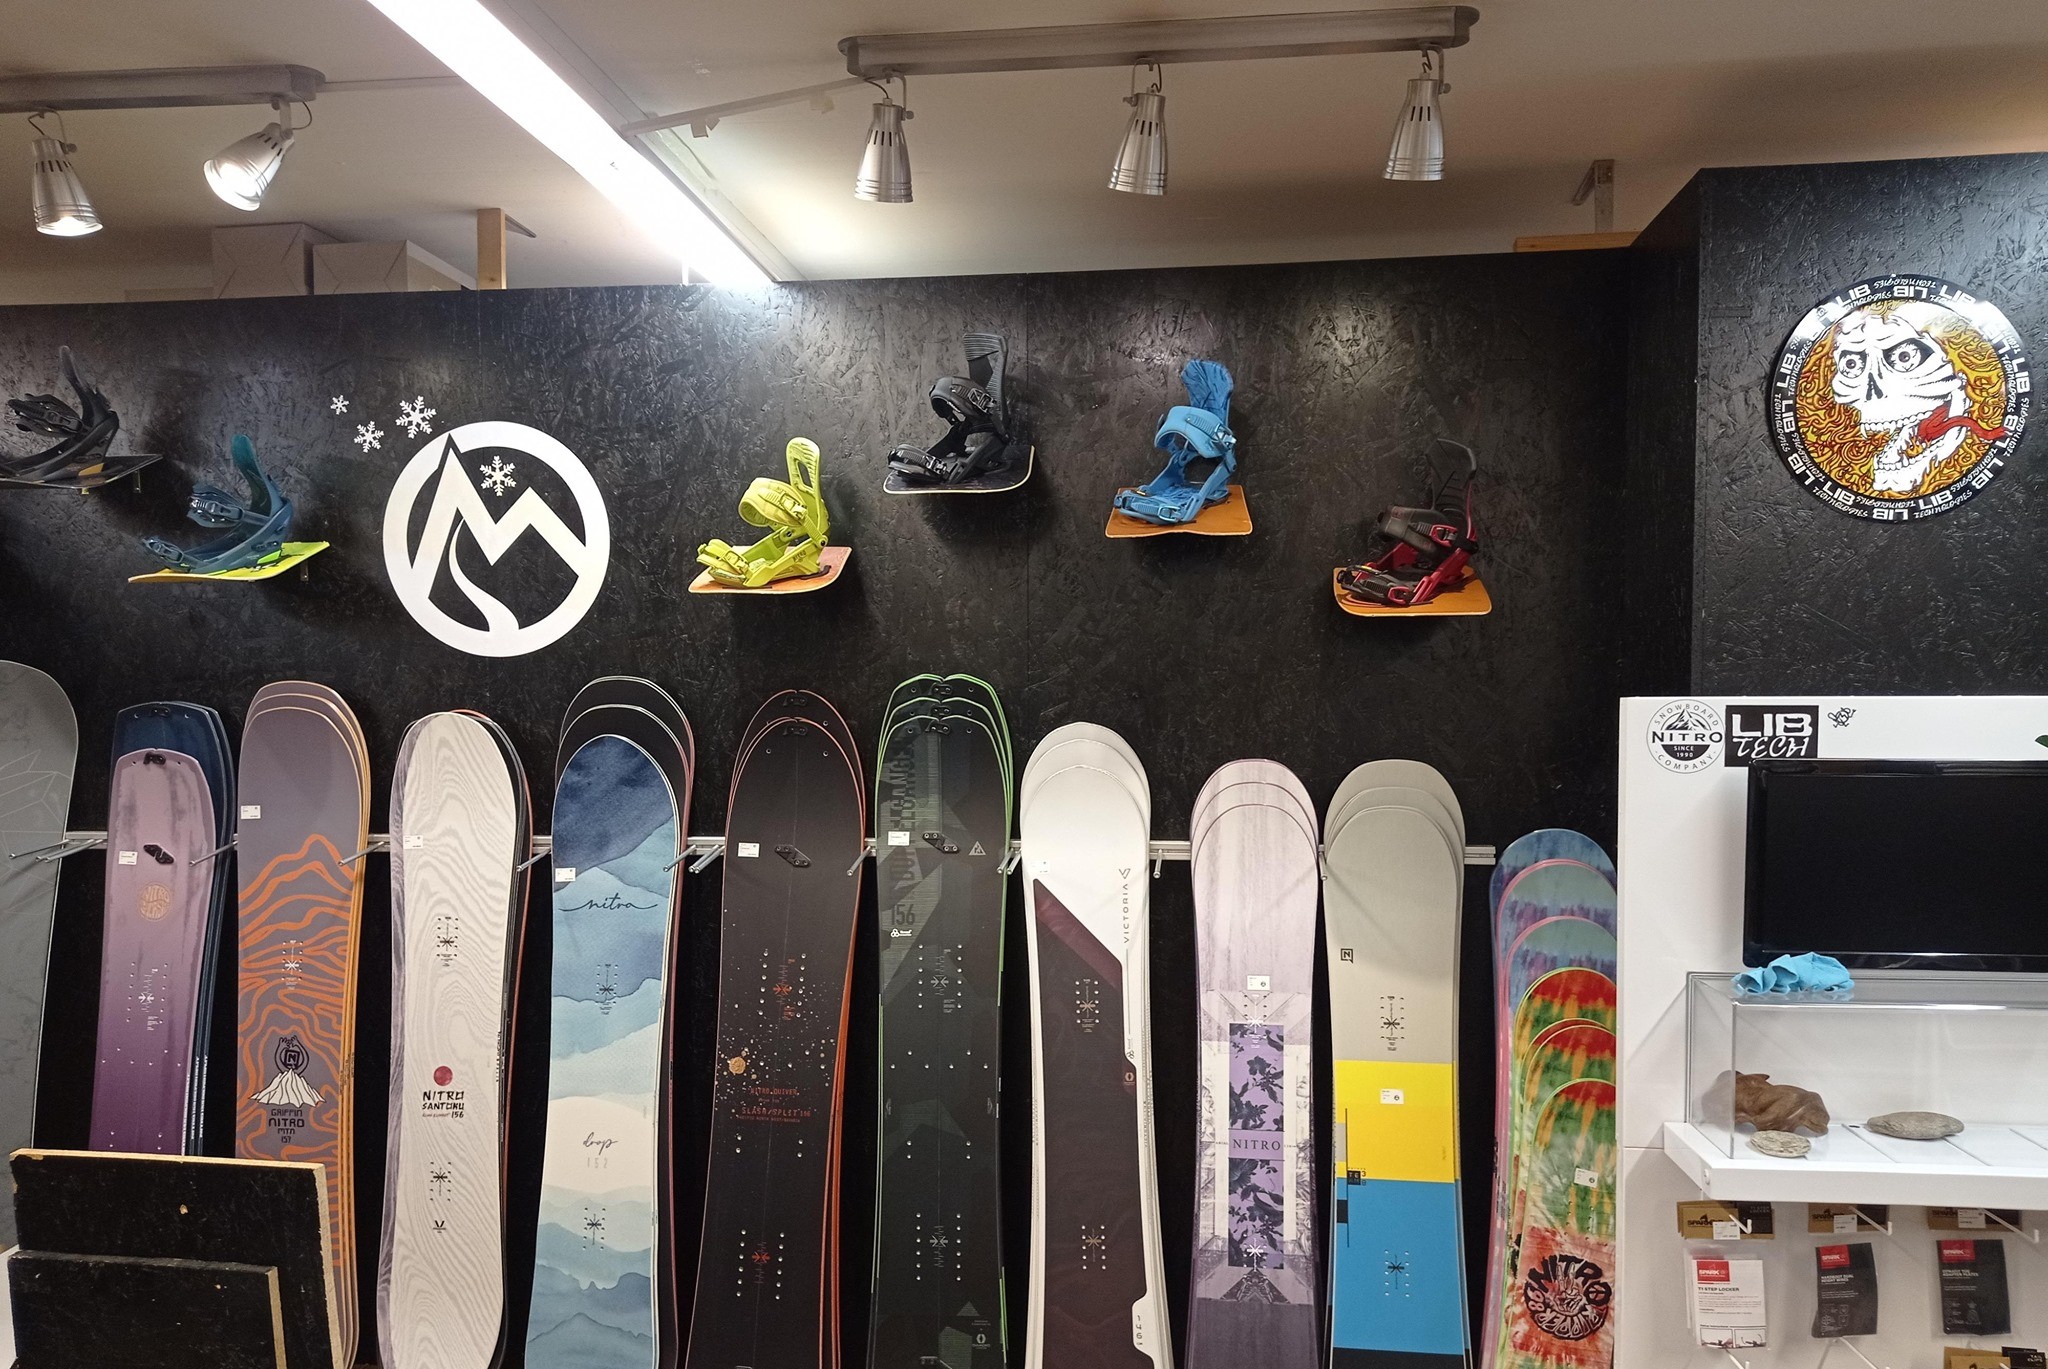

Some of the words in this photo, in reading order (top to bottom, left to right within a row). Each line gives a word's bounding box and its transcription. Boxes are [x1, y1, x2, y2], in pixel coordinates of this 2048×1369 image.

[1836, 284, 1871, 306] LIB
[1842, 290, 1892, 310] CHNOLOGIES
[1893, 285, 1929, 299] LIB
[1939, 285, 1977, 305] LIB
[1776, 353, 1797, 388] LIB
[2011, 357, 2030, 393] LIB
[1782, 399, 1796, 433] LIB
[1787, 453, 1816, 486] LIB
[1971, 457, 2005, 490] LIB
[1822, 482, 1856, 506] LIB
[1918, 489, 1954, 510] LIB
[1872, 507, 1910, 520] LIB
[1655, 704, 1719, 726] SNOWBOARD
[1732, 713, 1813, 737] LIB
[1652, 731, 1723, 743] NITRO
[1732, 736, 1810, 759] TECH
[1658, 754, 1714, 770] COMPANY
[891, 903, 916, 926] 156
[422, 1089, 465, 1102] NITRO
[422, 1101, 465, 1110] SANTOKU
[271, 1108, 303, 1117] GRIFFIN
[451, 1110, 464, 1119] 156
[268, 1118, 305, 1128] NITRO
[1233, 1138, 1281, 1152] NITRO
[586, 1157, 608, 1169] 152
[1528, 1254, 1612, 1306] NITRO
